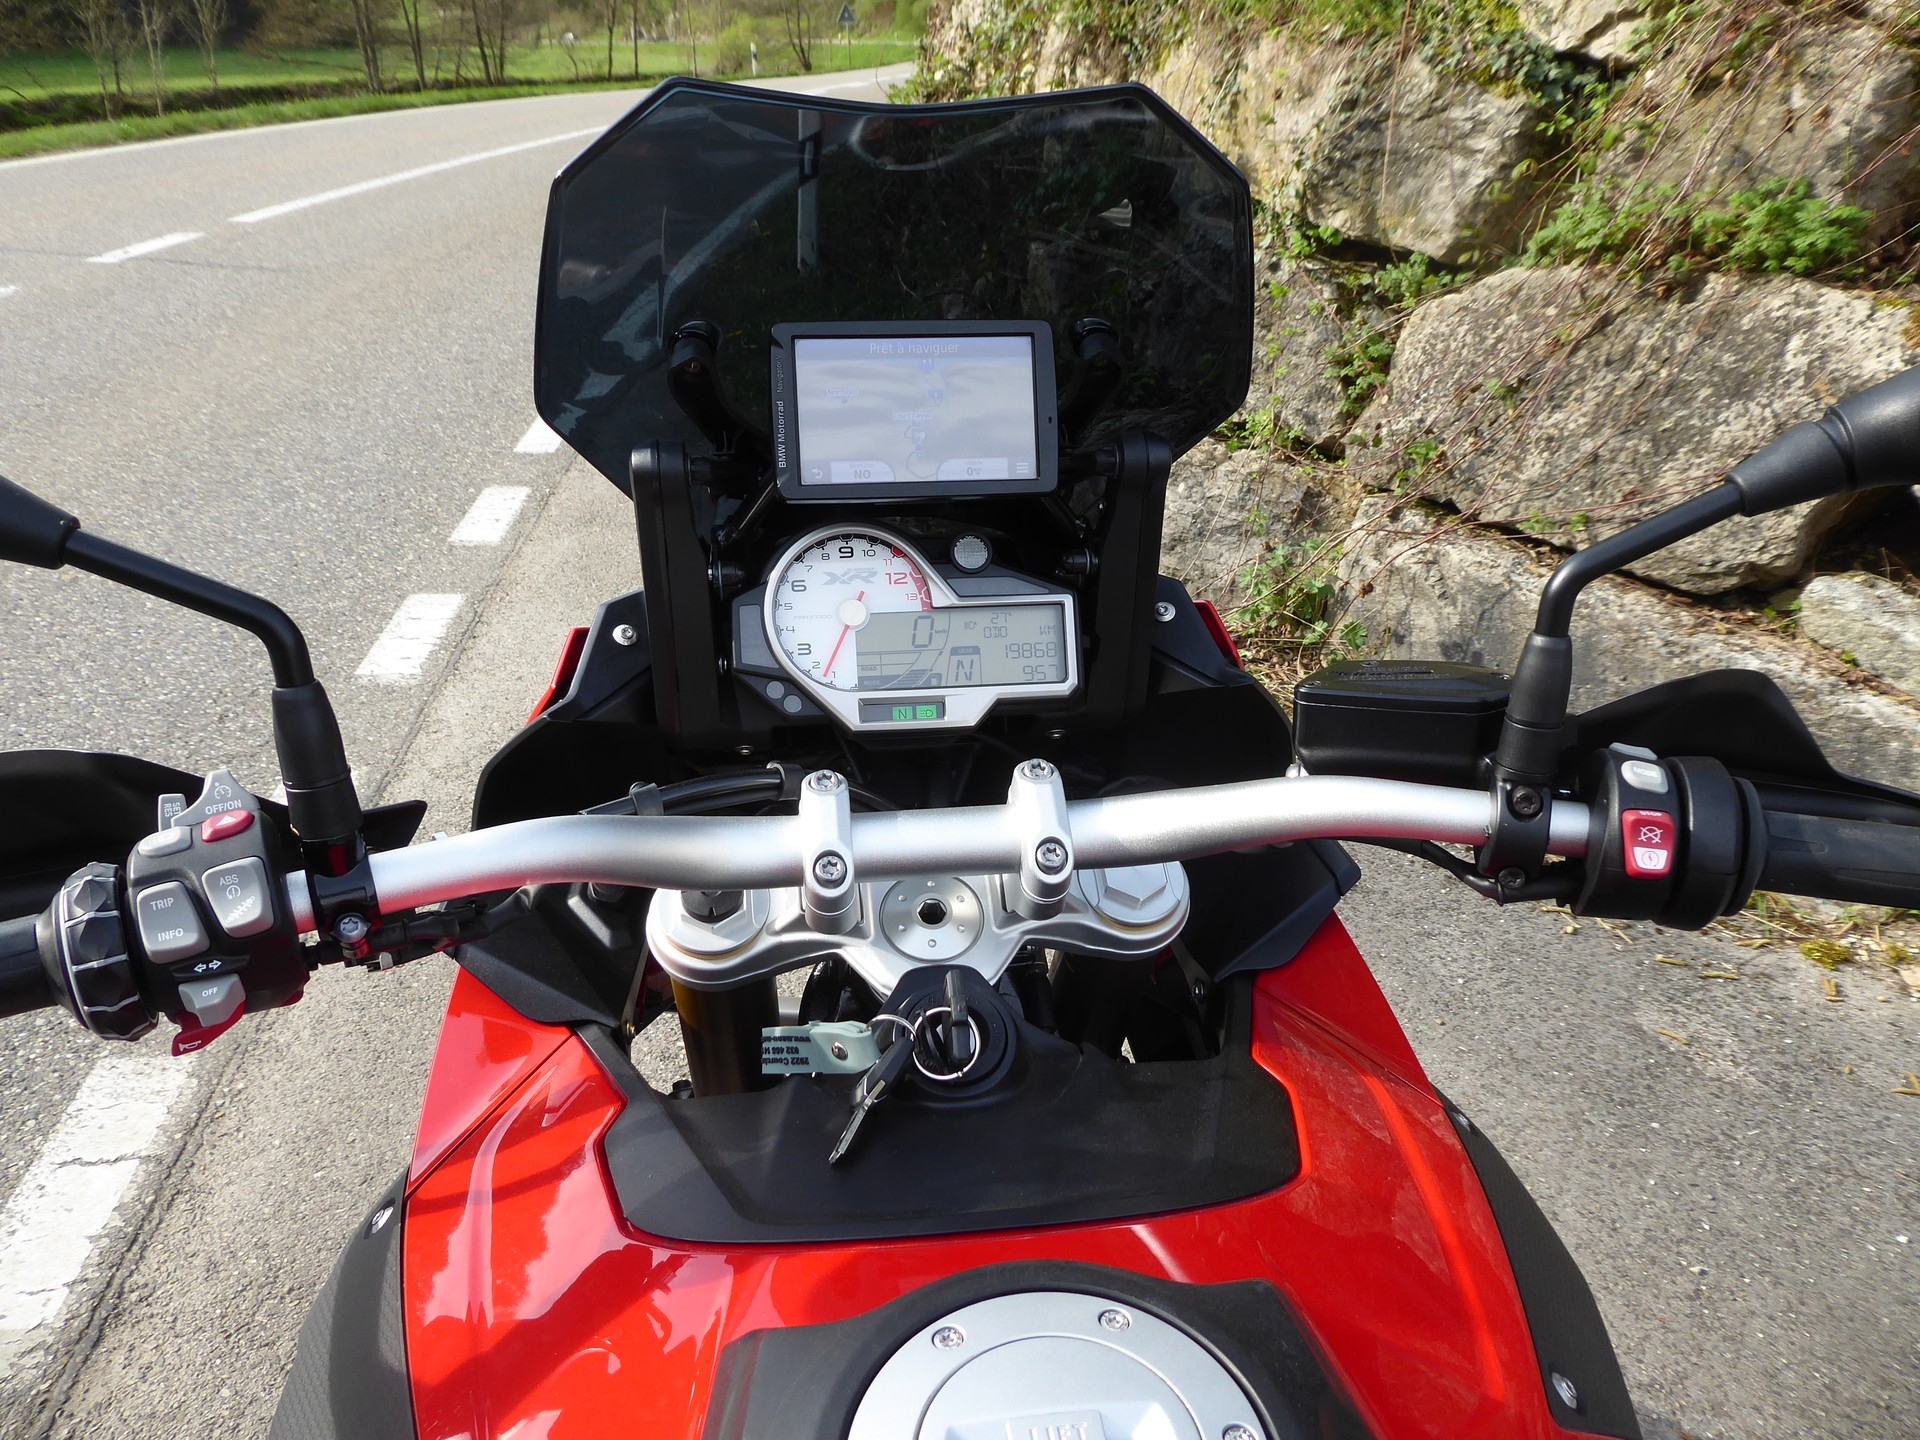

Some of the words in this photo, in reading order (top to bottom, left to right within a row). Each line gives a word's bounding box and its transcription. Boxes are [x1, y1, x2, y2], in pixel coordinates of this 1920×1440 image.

[897, 343, 904, 354] à
[908, 343, 959, 356] naviguer
[776, 363, 784, 392] Navigator
[776, 401, 786, 441] Motorrad
[778, 444, 787, 468] BMW
[854, 470, 871, 480] NO
[821, 552, 830, 560] 8
[838, 546, 854, 559] 9
[862, 549, 876, 557] 10
[883, 558, 893, 566] 11
[821, 570, 879, 585] XR
[885, 572, 908, 585] 12
[791, 579, 807, 592] 6
[784, 602, 793, 610] 5
[911, 615, 935, 648] 0
[1039, 625, 1056, 636] KM
[797, 643, 812, 656] 3
[1005, 642, 1057, 659] 19868
[812, 661, 821, 669] 2
[955, 659, 974, 682] N
[898, 709, 907, 719] N
[164, 803, 172, 817] RES
[205, 799, 242, 815] OFF/ON
[219, 874, 239, 886] ABS
[150, 897, 174, 911] TRIP
[158, 928, 184, 942] INFO
[202, 987, 218, 997] OFF
